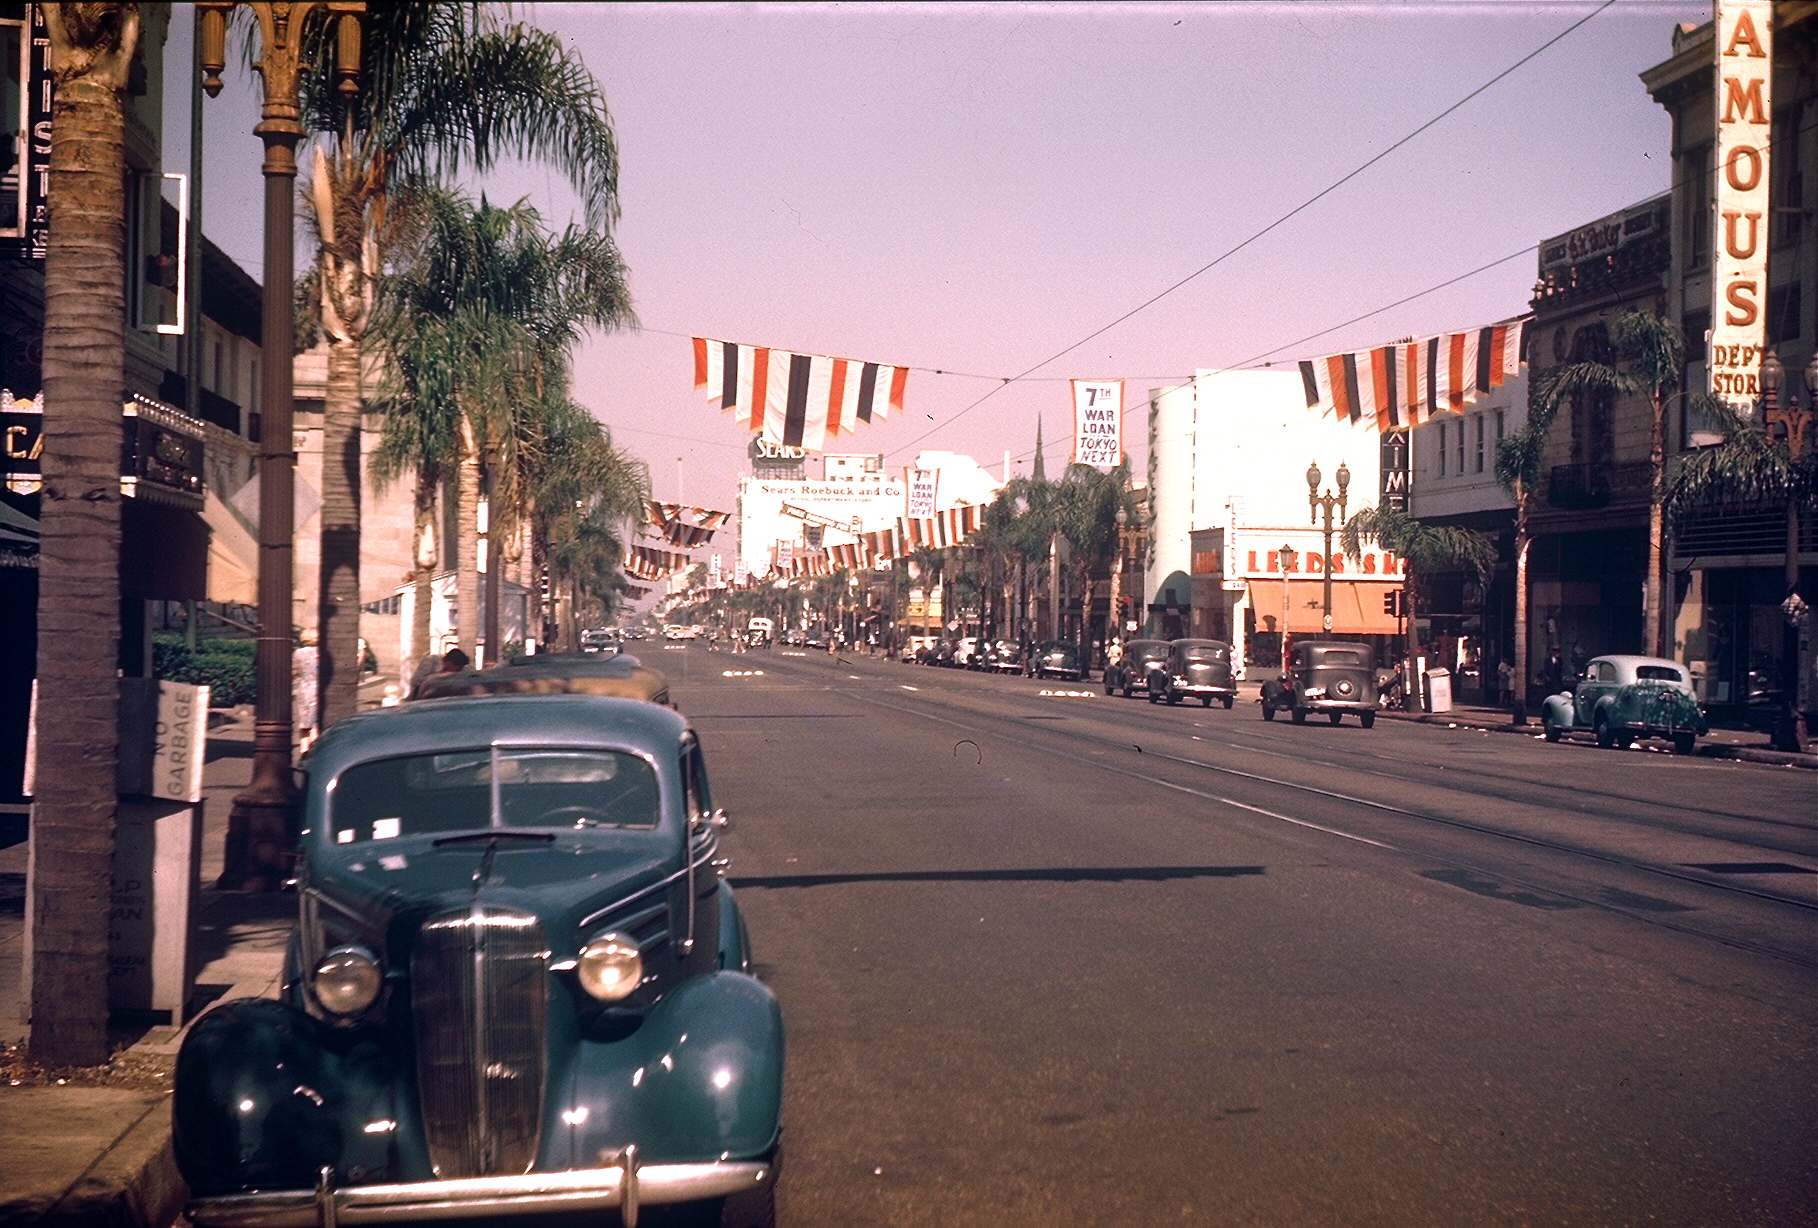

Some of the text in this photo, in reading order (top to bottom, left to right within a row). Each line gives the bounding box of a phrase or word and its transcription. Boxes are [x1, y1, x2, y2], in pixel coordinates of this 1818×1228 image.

[1720, 8, 1768, 328] AMOUS
[1085, 387, 1111, 407] 7TH
[1085, 409, 1114, 421] WAR
[1082, 423, 1116, 434] LOAN
[1080, 437, 1118, 450] TOKYO
[1080, 450, 1117, 463] NEXT
[801, 485, 854, 496] Roebuck
[858, 487, 881, 496] and
[913, 483, 932, 491] WAR
[911, 491, 932, 499] LOAN
[1247, 550, 1345, 574] LEEDS
[167, 691, 192, 796] GARBAGE
